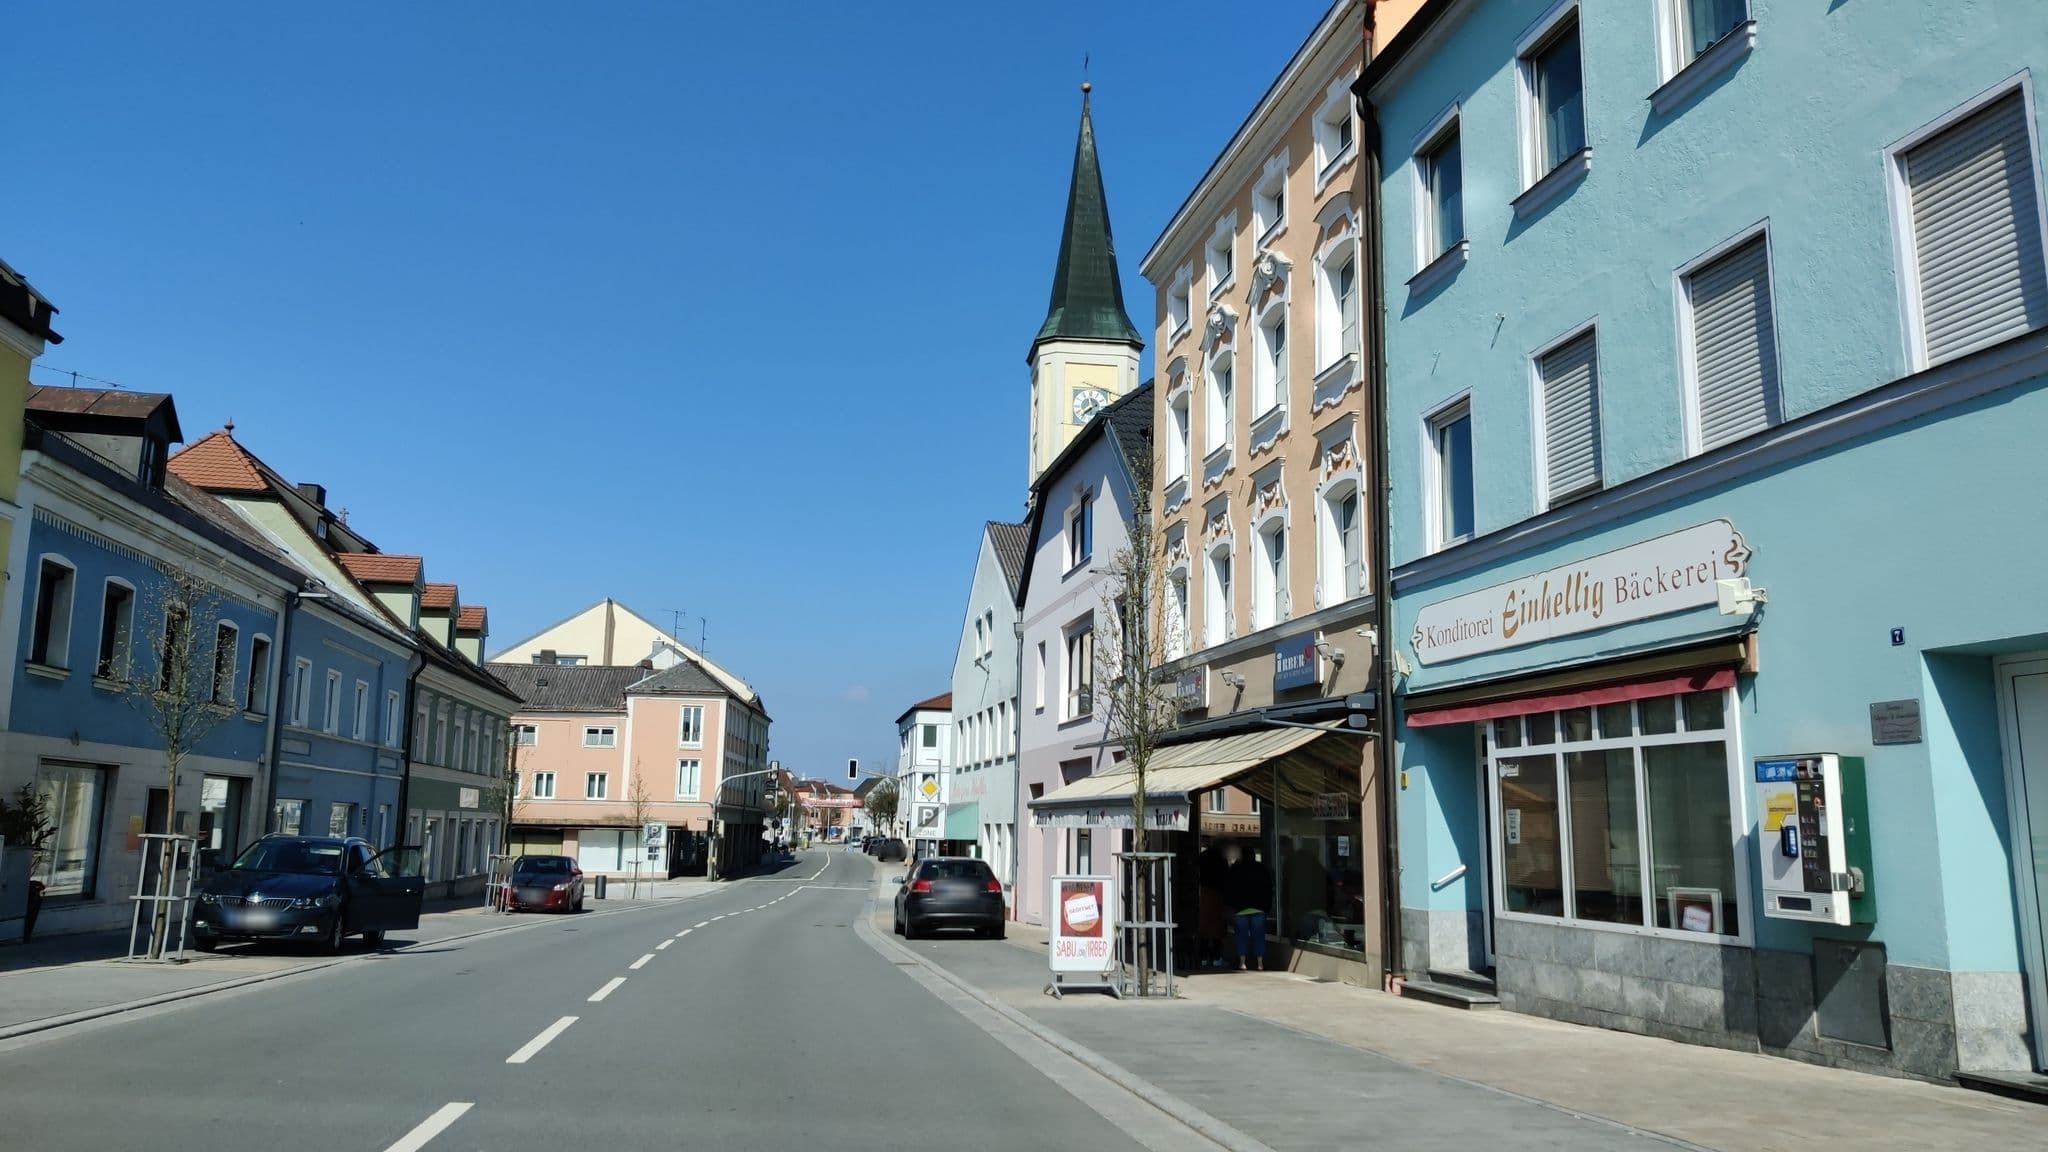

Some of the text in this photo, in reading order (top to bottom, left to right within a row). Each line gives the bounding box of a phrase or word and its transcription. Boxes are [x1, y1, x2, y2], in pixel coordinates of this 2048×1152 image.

[1427, 551, 1717, 648] Konditorei Einhellig Bäckerei
[1894, 630, 1901, 642] 7
[922, 808, 934, 825] P
[1056, 940, 1077, 958] SABU
